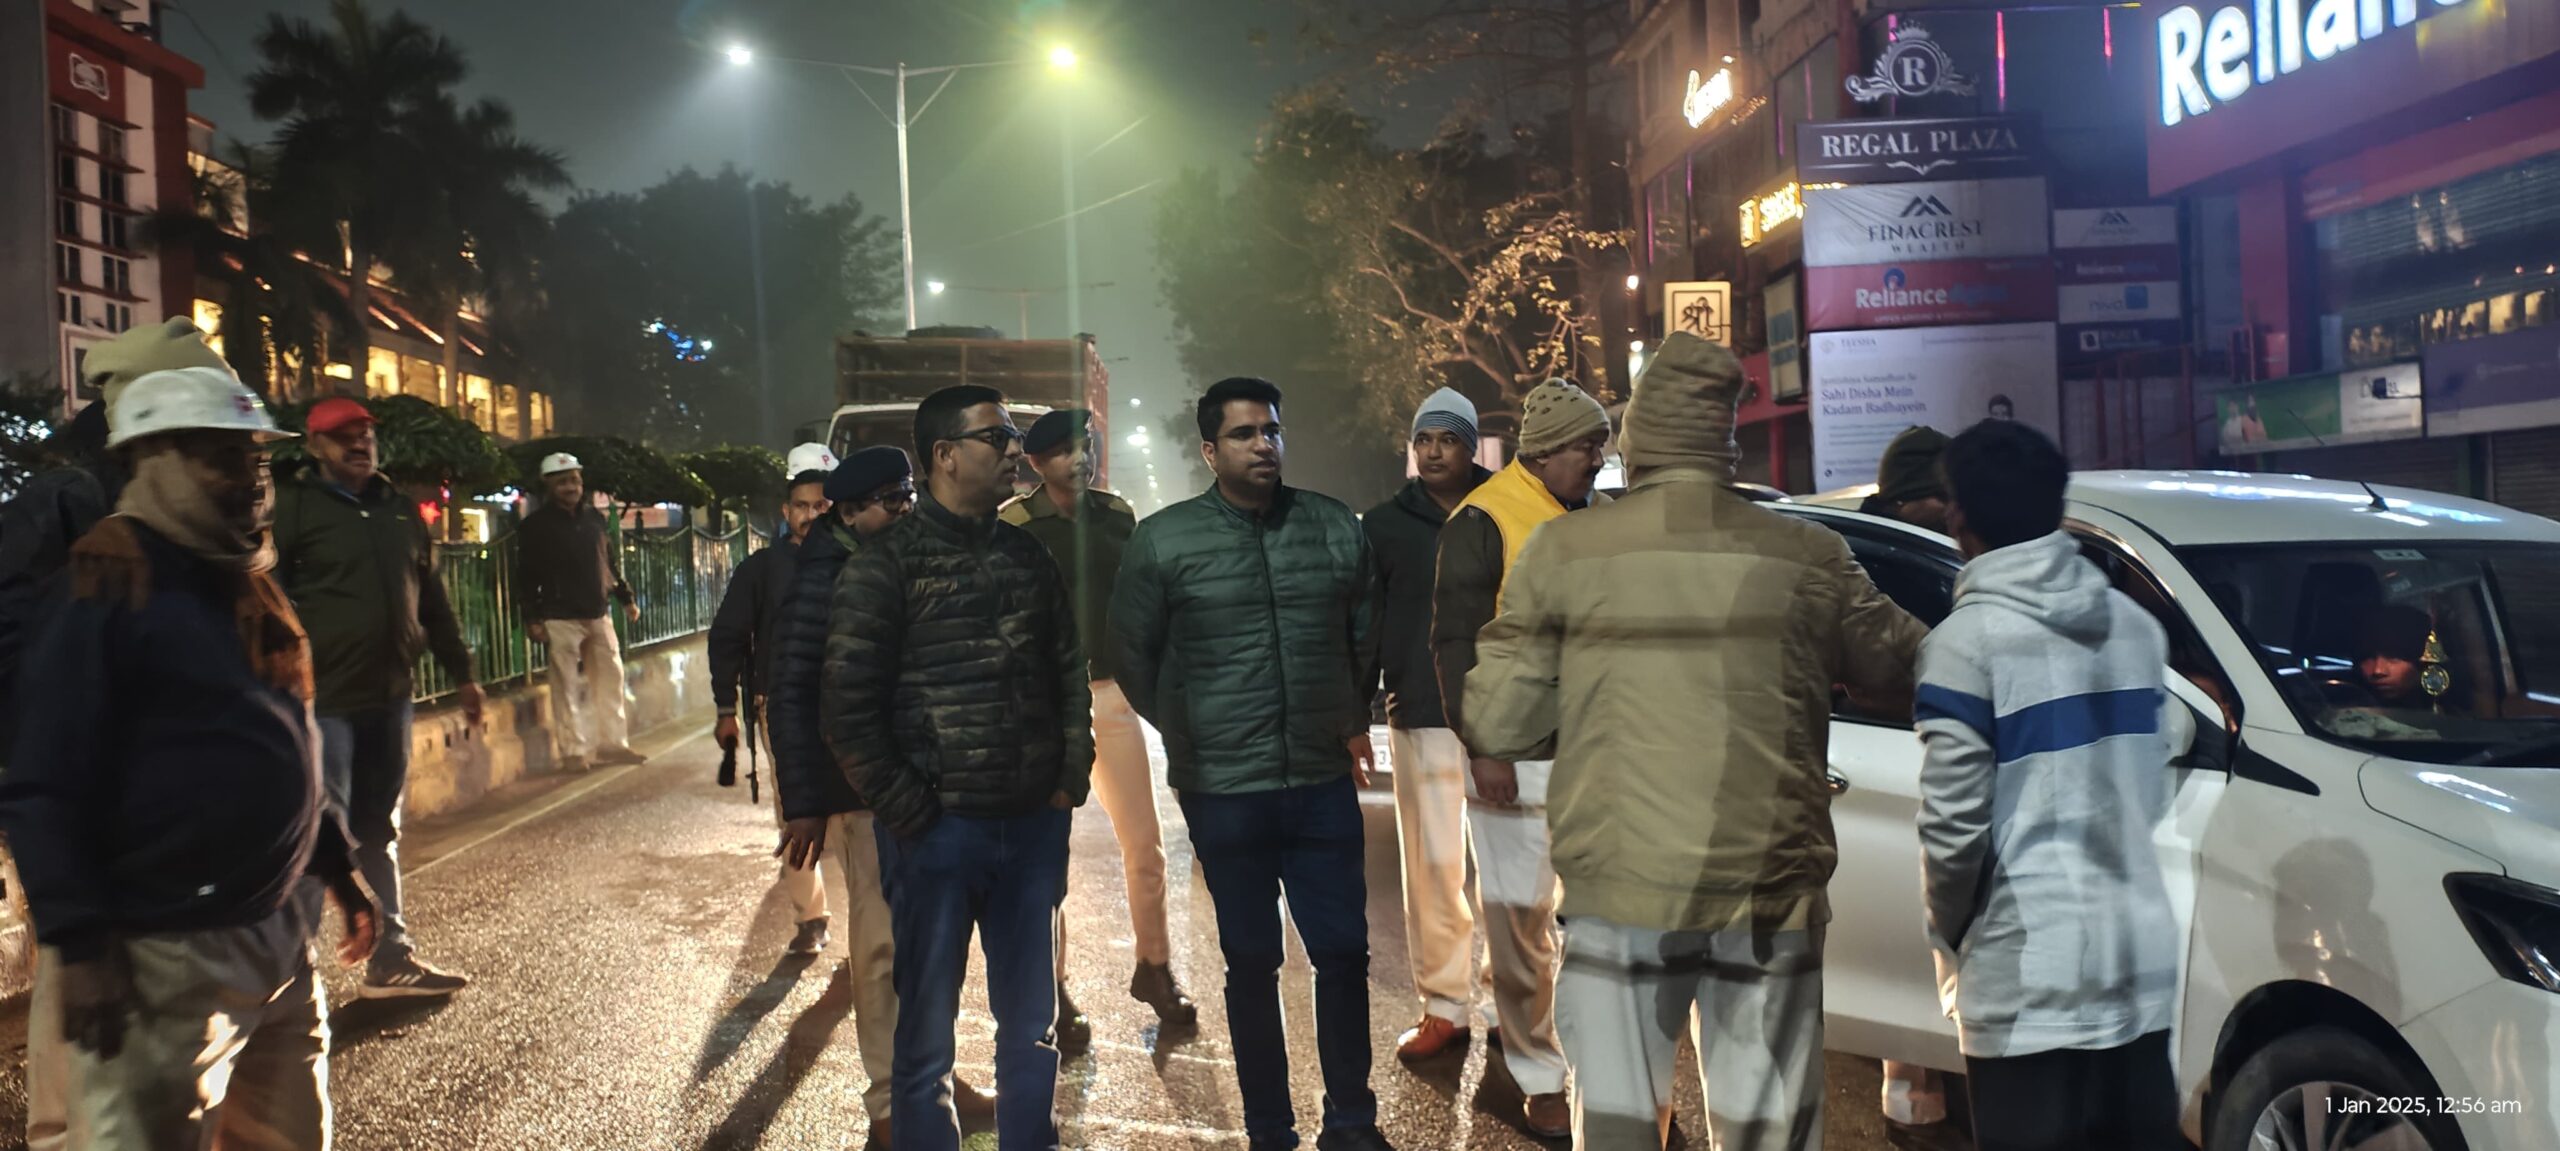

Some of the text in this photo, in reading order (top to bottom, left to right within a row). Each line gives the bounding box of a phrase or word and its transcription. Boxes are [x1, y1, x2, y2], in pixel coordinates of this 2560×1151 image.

[1901, 56, 1928, 86] R
[2157, 0, 2466, 126] Relia
[1822, 128, 2019, 158] REGAL PLAZA
[1868, 219, 1984, 242] FINACREST
[1856, 285, 1947, 308] Reliance
[1822, 387, 1846, 401] Sahi
[1849, 386, 1882, 400] Disha
[1823, 402, 1863, 416] Kadam
